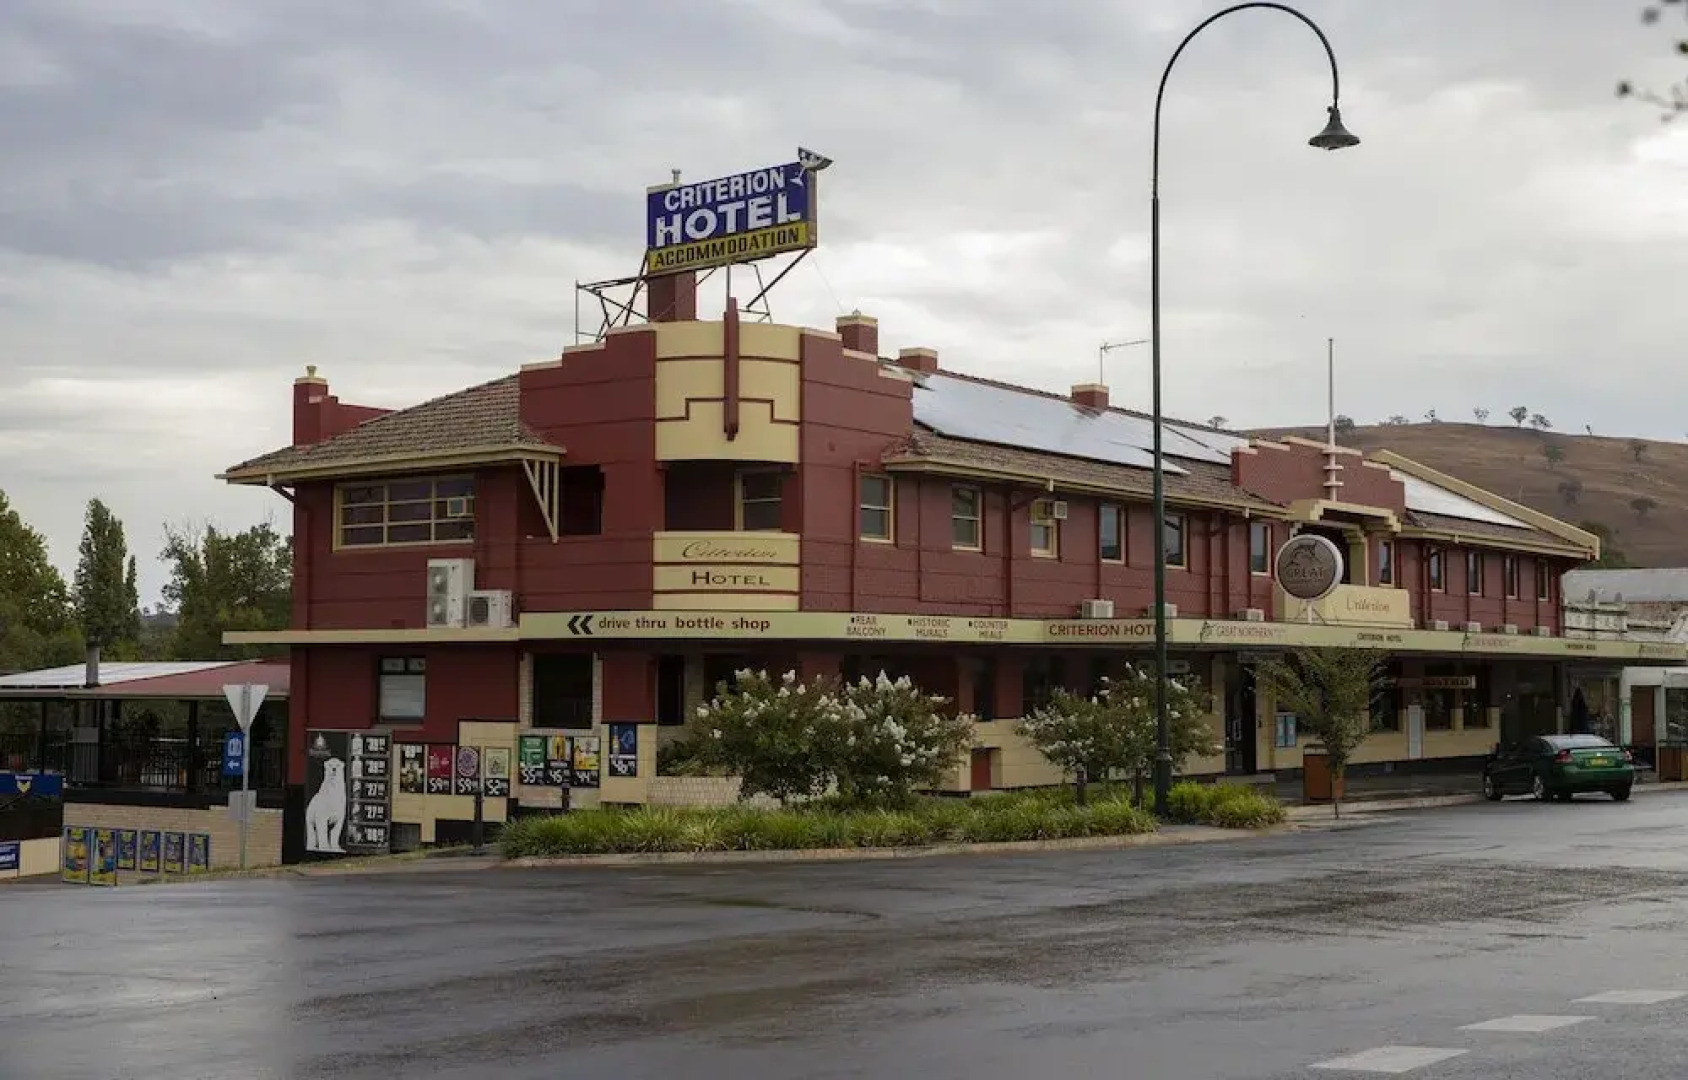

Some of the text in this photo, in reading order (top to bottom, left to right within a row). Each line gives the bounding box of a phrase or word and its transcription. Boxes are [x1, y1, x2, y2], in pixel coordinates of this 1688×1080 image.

[664, 166, 786, 211] CRITERION
[655, 193, 801, 247] HOTEL
[654, 227, 800, 267] ACCOMMODATION
[598, 616, 771, 632] drive thru bottle shop
[855, 616, 877, 625] REAR
[912, 618, 950, 628] HISTORIC
[973, 620, 1009, 630] COUNTER
[846, 626, 886, 637] BALCONY
[916, 629, 948, 638] MURALS
[1049, 623, 1168, 637] CRITERION HOT
